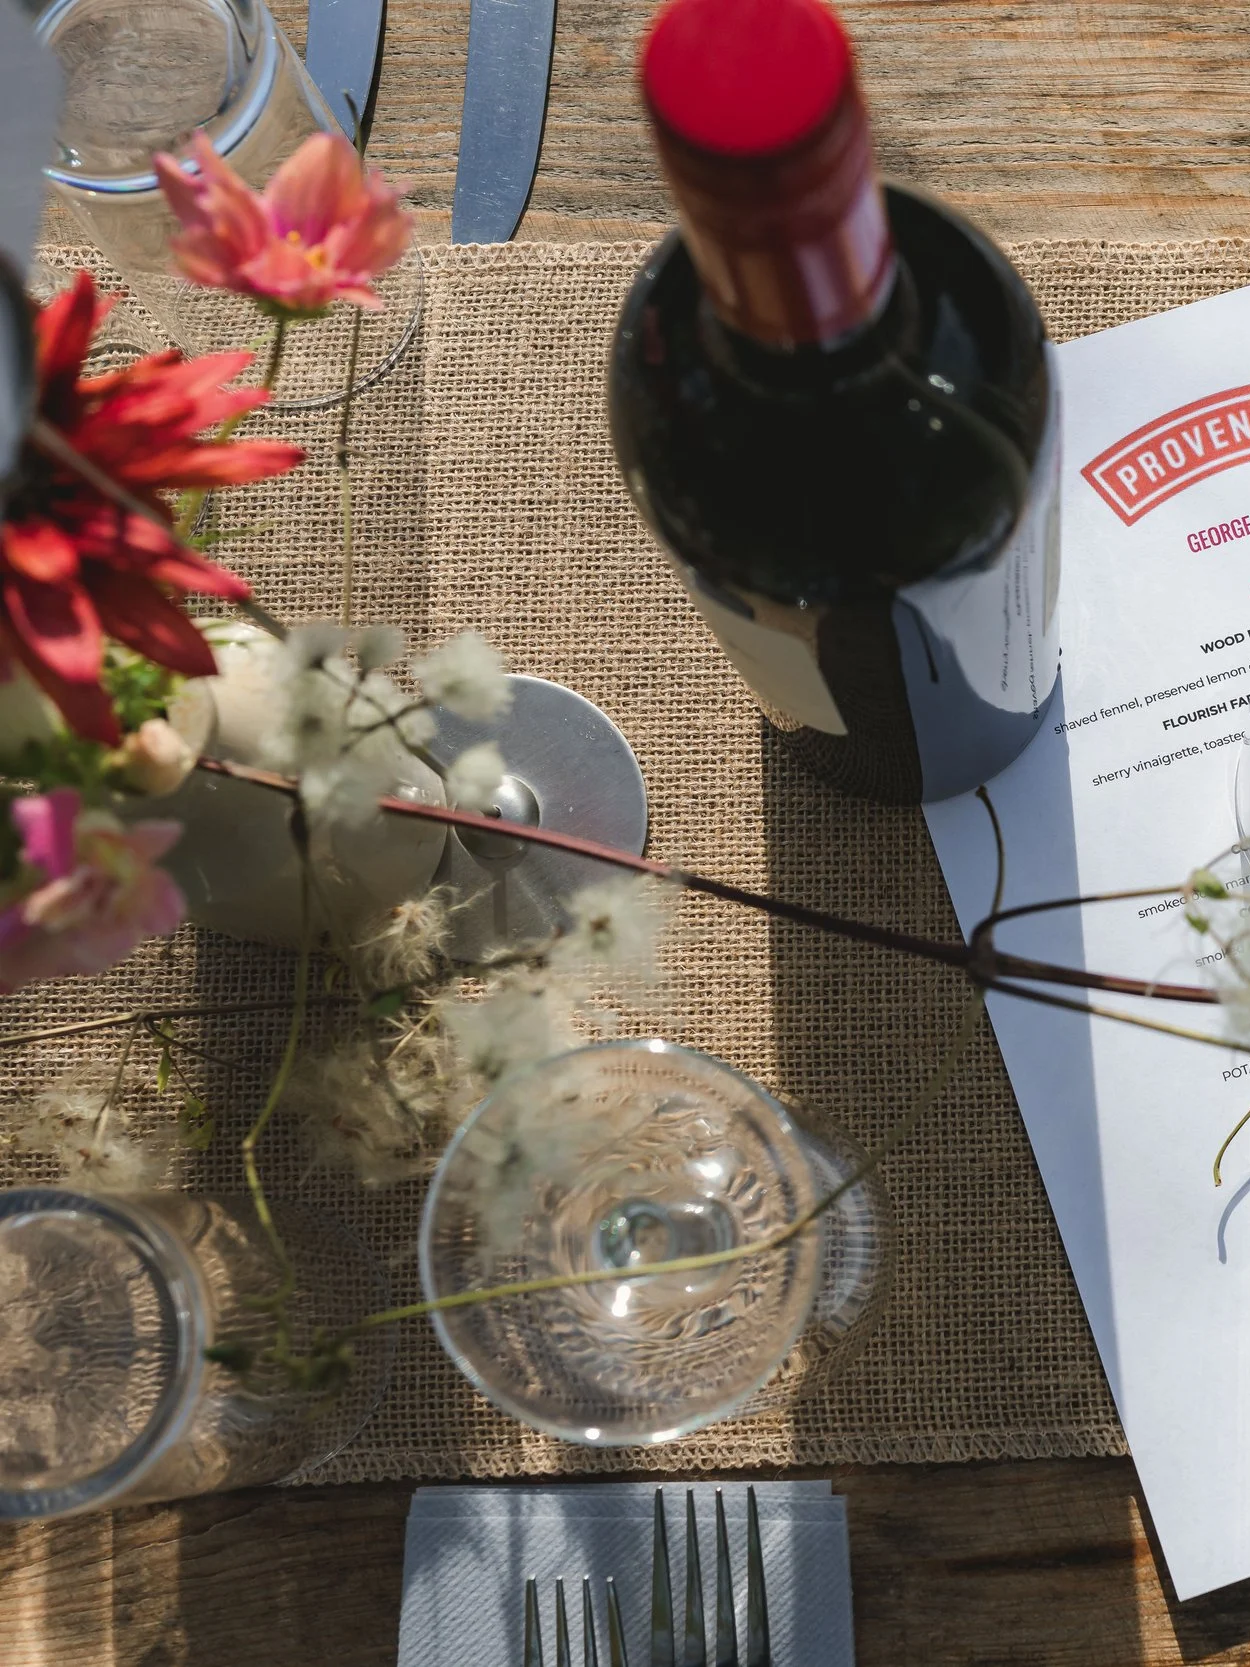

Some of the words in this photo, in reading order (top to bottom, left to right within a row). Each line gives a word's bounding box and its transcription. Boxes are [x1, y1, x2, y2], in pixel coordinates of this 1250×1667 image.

[1200, 631, 1245, 654] WOOD
[1053, 707, 1098, 735] shaved
[1099, 696, 1144, 720] fennel,
[1144, 677, 1206, 707] preserved
[1206, 665, 1248, 686] lemon
[1162, 702, 1228, 731] FLOURISH
[1092, 767, 1131, 788] sherry
[1132, 745, 1204, 774] vinaigrette,
